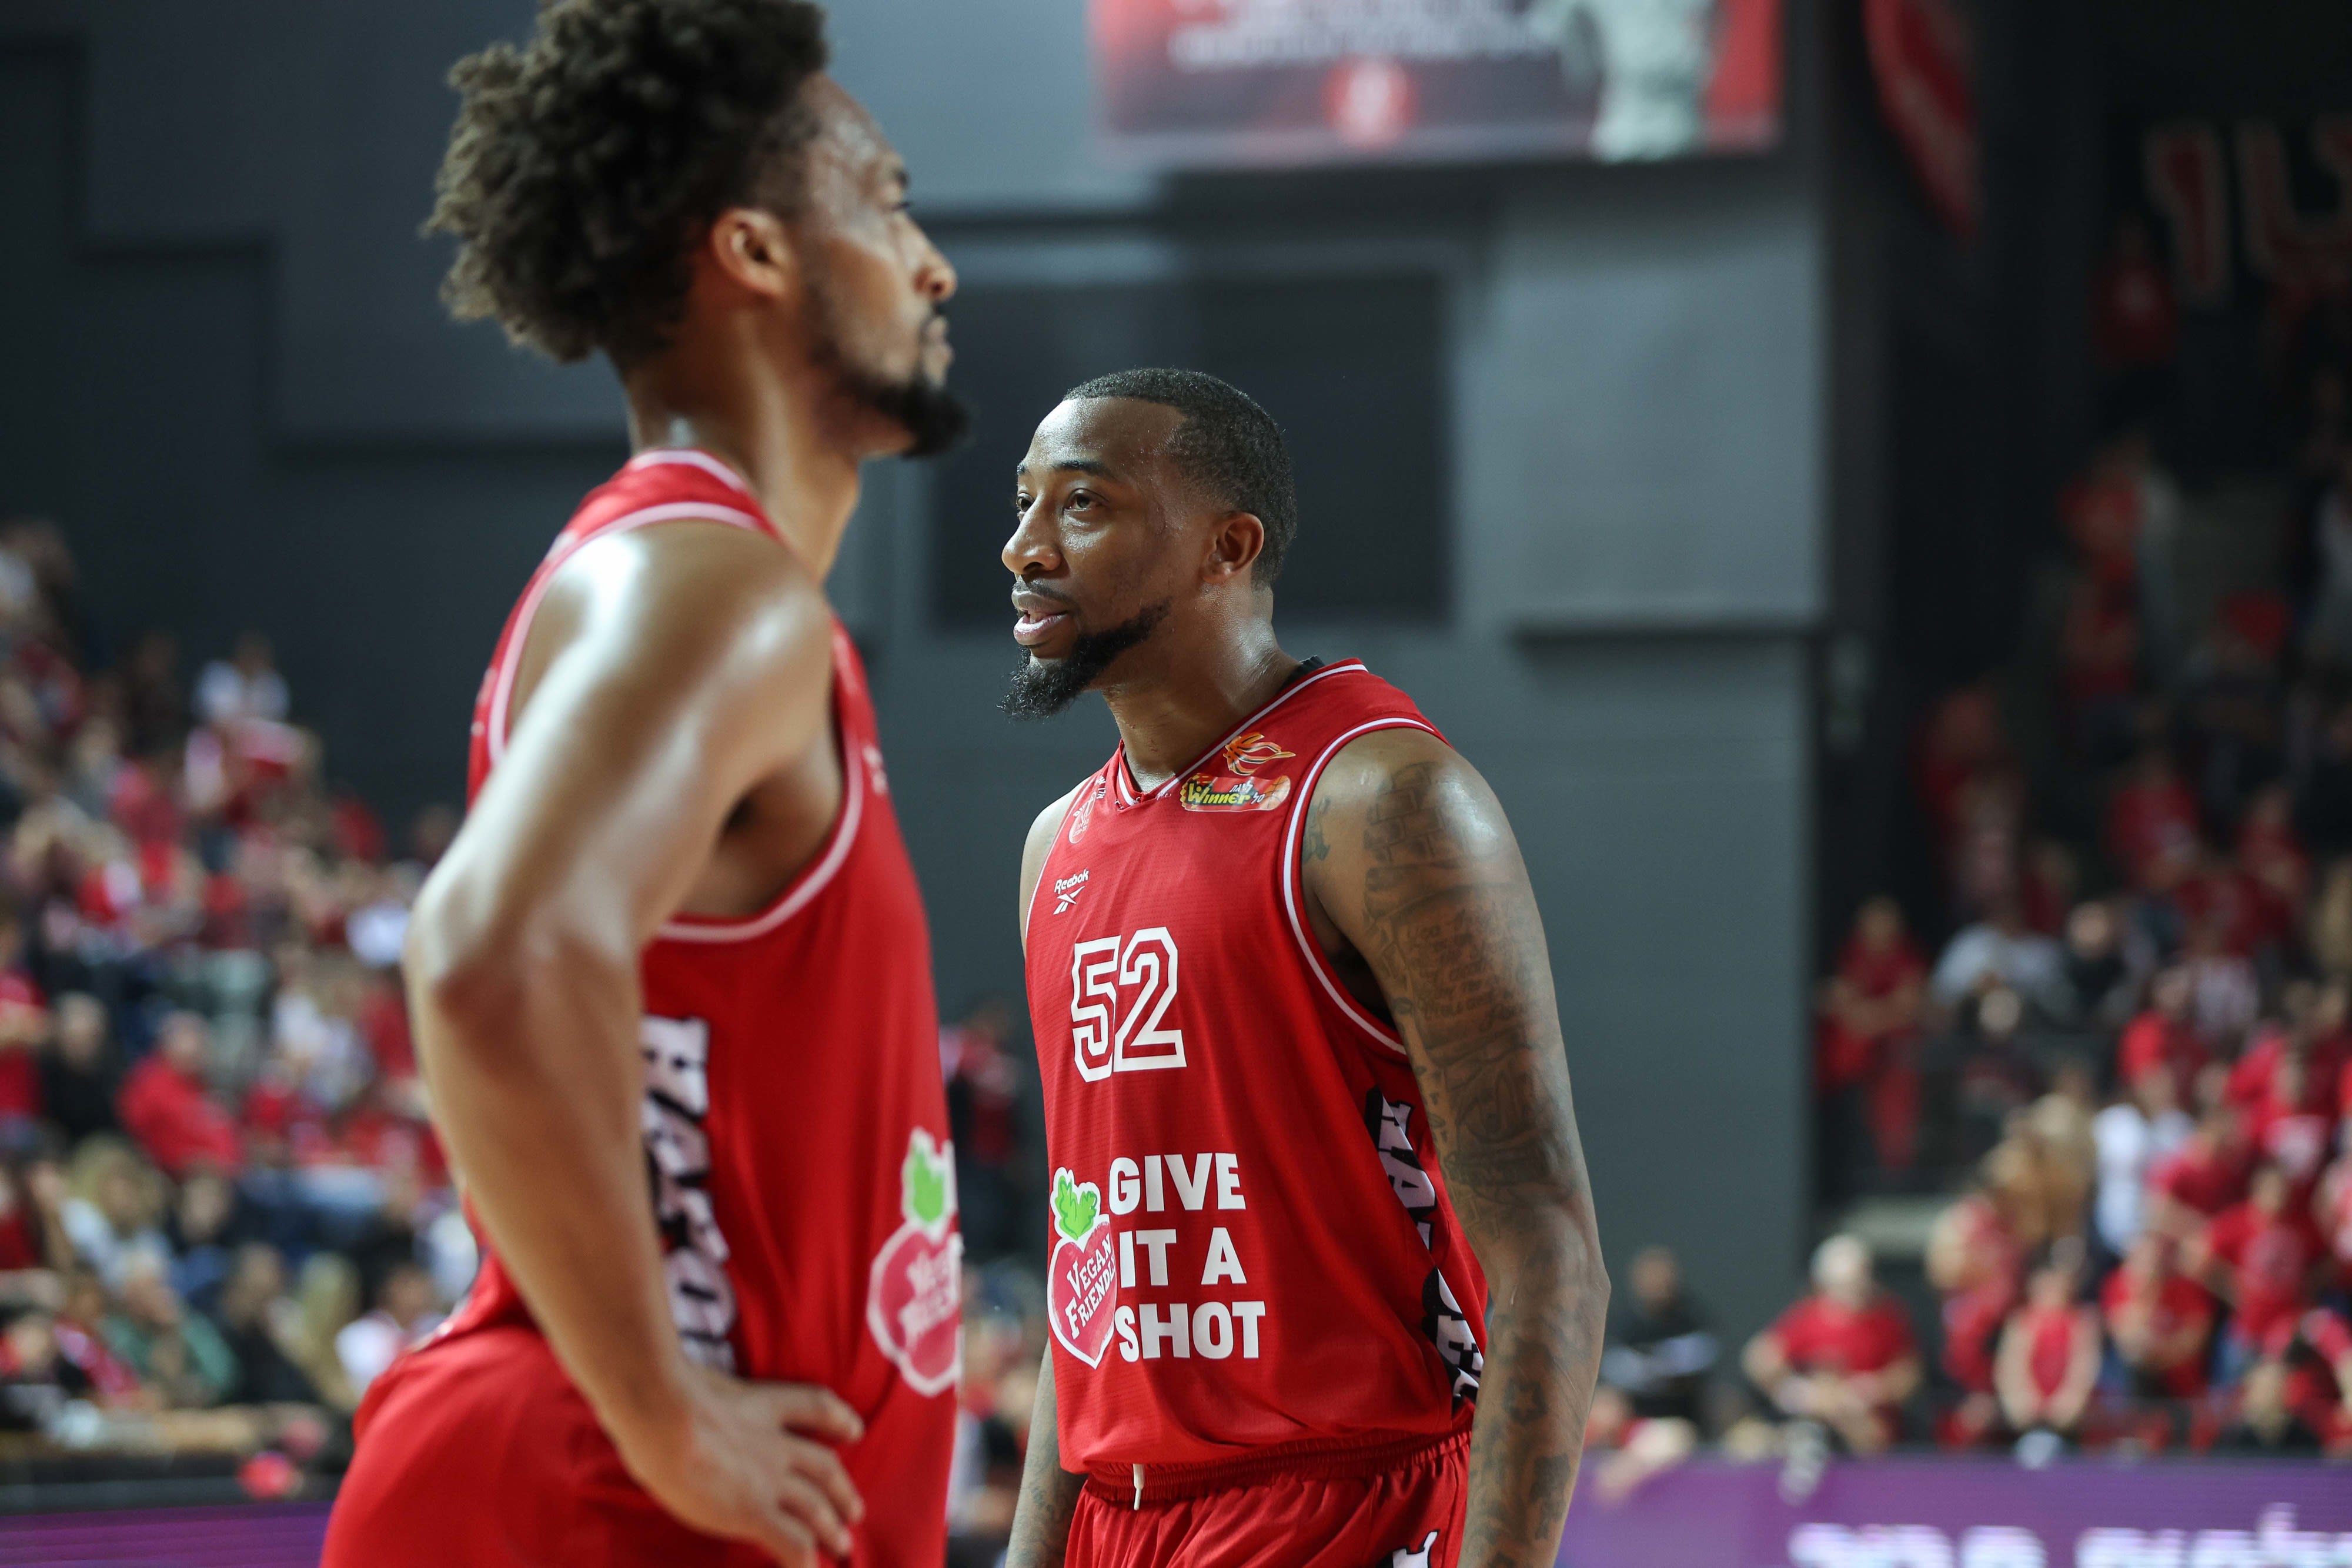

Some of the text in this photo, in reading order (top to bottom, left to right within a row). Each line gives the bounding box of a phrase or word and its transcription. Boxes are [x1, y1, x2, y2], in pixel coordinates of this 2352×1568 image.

[1188, 782, 1251, 805] Winner
[1054, 868, 1090, 894] Reebok
[1071, 926, 1187, 1083] 52
[1108, 1152, 1247, 1216] GIVE
[1066, 1232, 1112, 1300] VEGAN
[1119, 1227, 1247, 1289] IT A
[1114, 1300, 1266, 1363] SHOT
